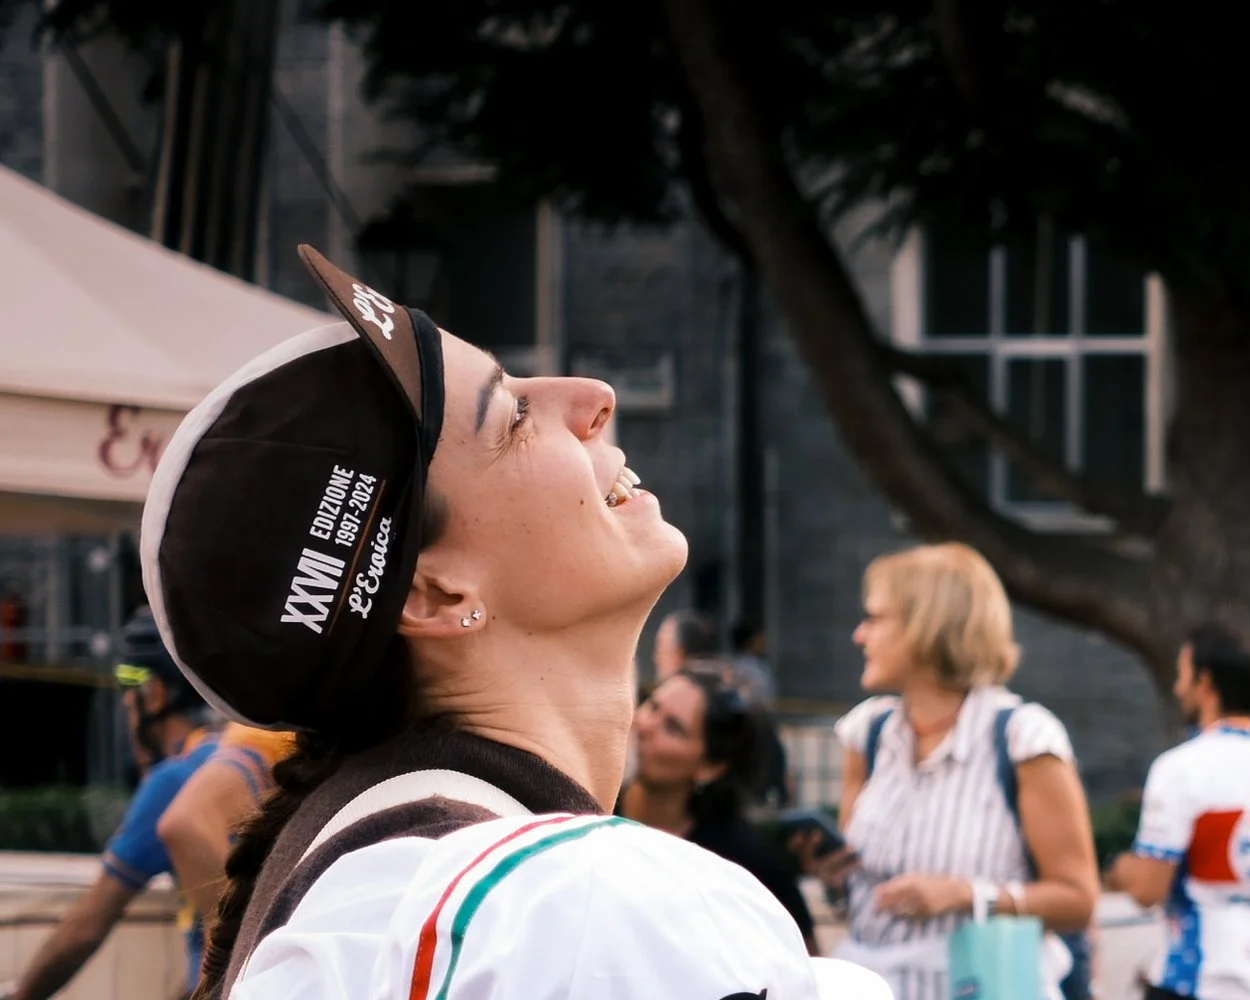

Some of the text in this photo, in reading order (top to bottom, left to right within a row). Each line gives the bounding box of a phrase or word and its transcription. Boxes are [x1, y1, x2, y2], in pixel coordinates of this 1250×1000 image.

[309, 464, 355, 541] EDIZIONE
[334, 473, 377, 547] 1997-2024
[280, 547, 346, 635] XXVII
[348, 516, 393, 620] L'Eroica
